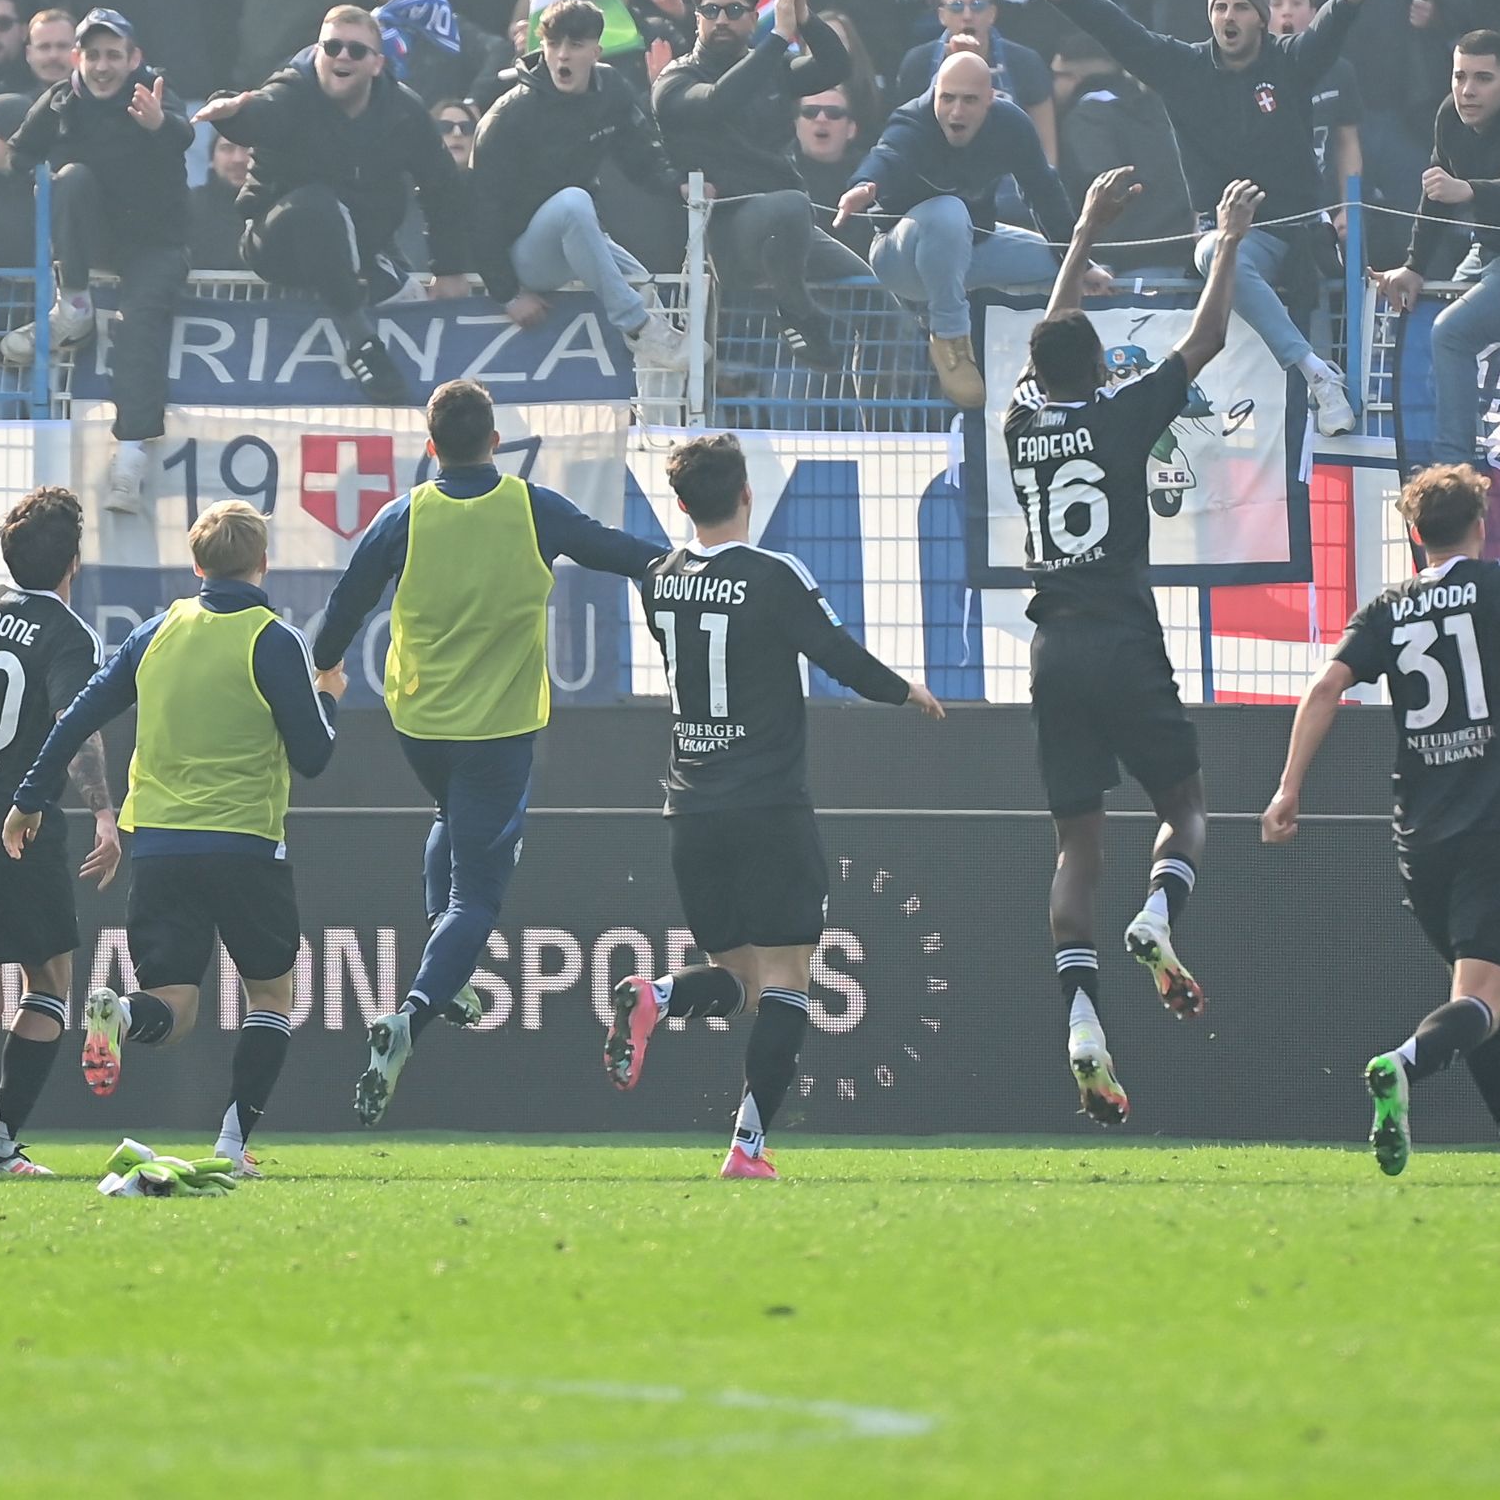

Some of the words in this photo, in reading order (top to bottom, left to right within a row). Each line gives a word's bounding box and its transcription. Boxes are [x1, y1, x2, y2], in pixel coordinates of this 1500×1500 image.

[1017, 426, 1095, 464] FADERA
[1158, 470, 1190, 484] S.G.
[1012, 458, 1110, 564] 16
[653, 573, 748, 605] DOUVIKAS
[654, 610, 729, 718] 11
[1390, 611, 1490, 730] 31
